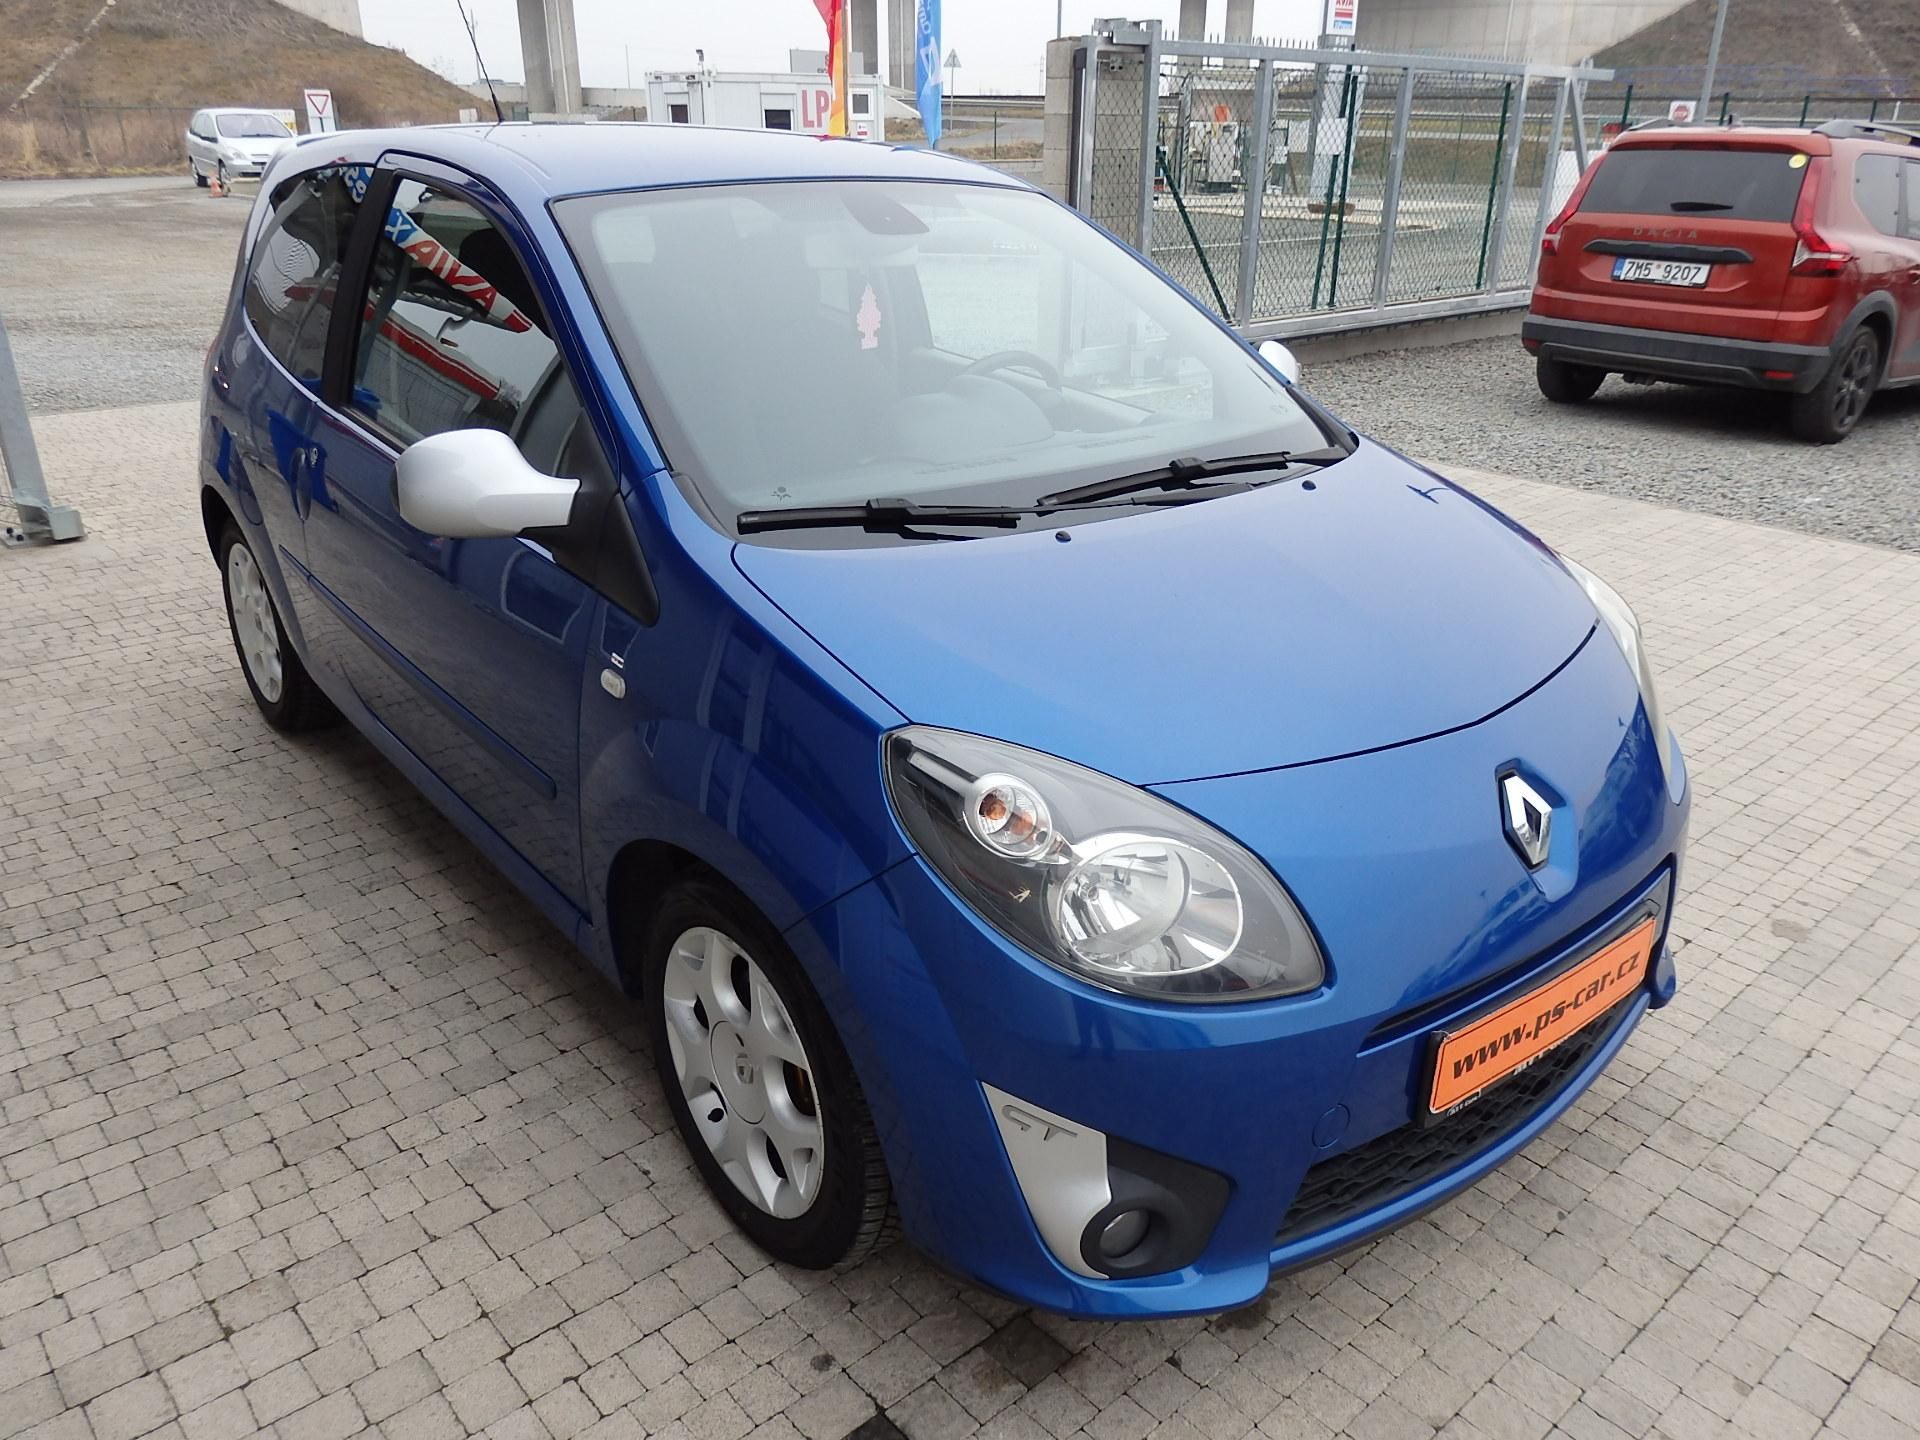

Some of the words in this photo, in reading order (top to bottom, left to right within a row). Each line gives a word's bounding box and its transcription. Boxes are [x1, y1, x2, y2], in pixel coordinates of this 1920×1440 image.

[1632, 224, 1698, 239] DACIA
[1624, 260, 1654, 277] 7M5
[1662, 263, 1702, 282] 9207
[1452, 950, 1640, 1080] www.ps-car.cz
